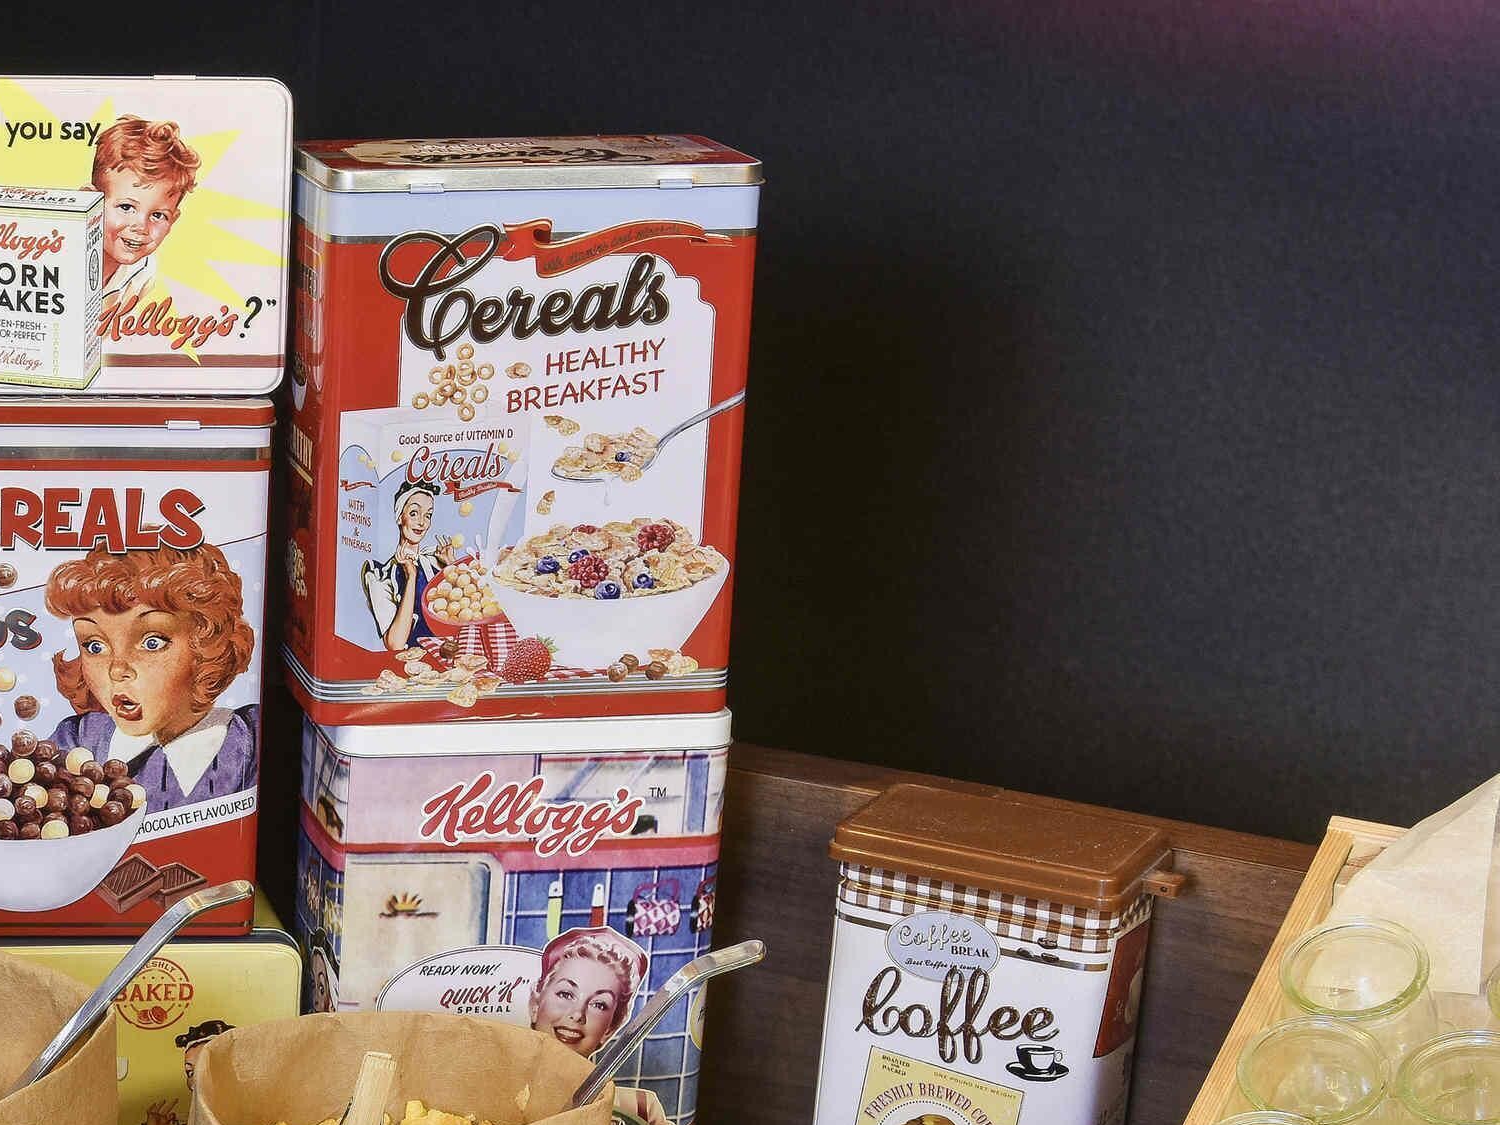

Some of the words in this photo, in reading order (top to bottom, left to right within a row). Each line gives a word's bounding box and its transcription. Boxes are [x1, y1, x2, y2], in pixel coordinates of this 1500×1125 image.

[6, 118, 52, 147] you
[21, 194, 76, 203] FLAKES
[377, 224, 670, 360] Cereals
[545, 337, 667, 377] HEALTHY
[506, 369, 666, 414] BREAKFAST
[399, 434, 421, 445] Good
[423, 433, 453, 444] Source
[455, 431, 465, 442] of
[466, 429, 507, 441] VITAMIN
[508, 428, 514, 438] D
[407, 442, 504, 483] Cereals
[348, 499, 365, 511] WITH
[341, 512, 372, 527] VITAMINS
[341, 535, 373, 553] MINERALS
[138, 811, 192, 833] HOCOLATE
[193, 797, 256, 823] FLAVOURED
[421, 772, 643, 855] Kellogg's
[649, 787, 667, 798] TM
[899, 924, 972, 951] Coffee
[951, 945, 990, 958] BREAK
[419, 965, 460, 976] READY
[460, 963, 502, 976] NOW!
[925, 959, 948, 969] Coffee
[440, 985, 496, 1008] QUICK
[457, 1006, 511, 1014] SPECIAL
[864, 1082, 914, 1119] FRESHLY
[918, 1082, 973, 1112] BREWED
